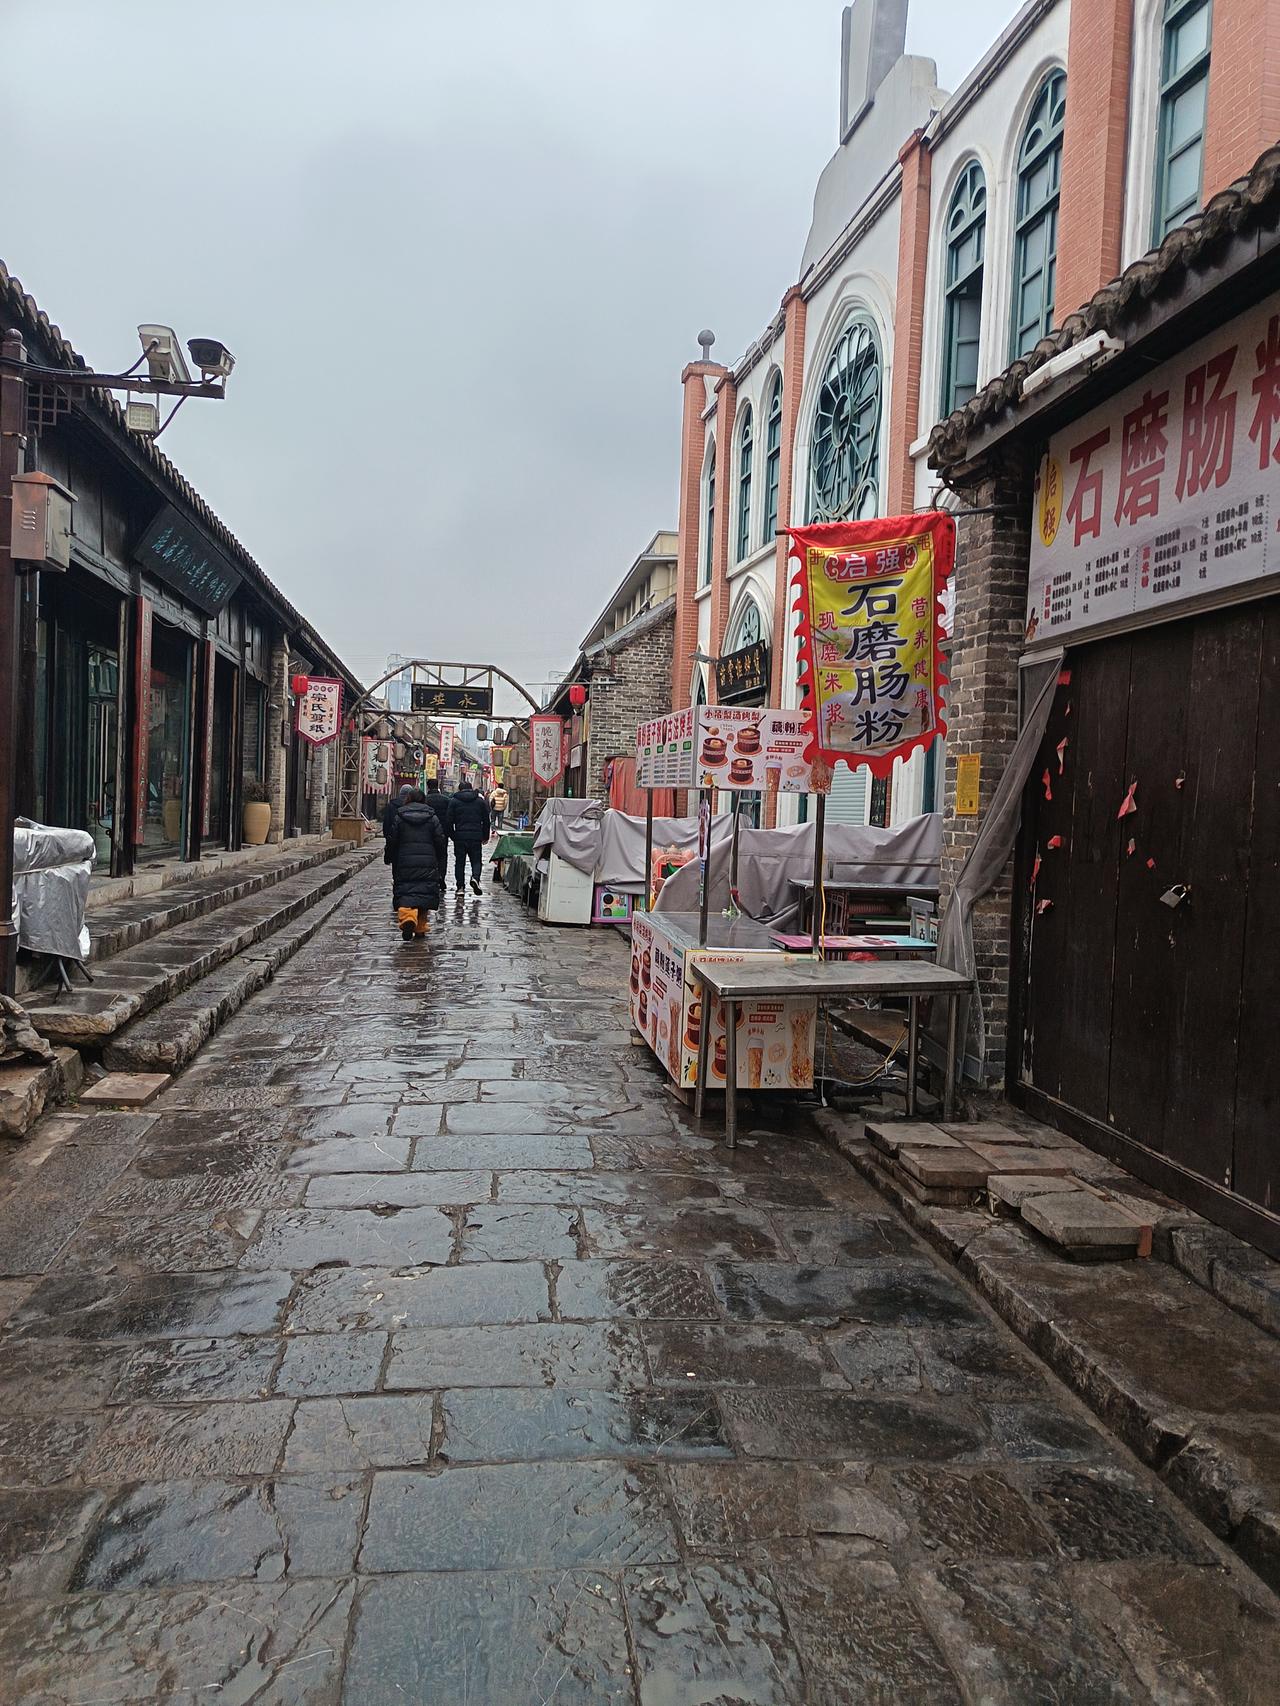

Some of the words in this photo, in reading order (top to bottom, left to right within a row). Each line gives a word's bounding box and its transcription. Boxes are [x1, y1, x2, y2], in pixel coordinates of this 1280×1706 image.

[840, 549, 902, 578] 启强
[818, 611, 845, 724] 现磨米浆
[841, 578, 910, 747] 石磨肠粉
[911, 597, 929, 709] 营养健康
[308, 692, 328, 734] 宗氏剪纸
